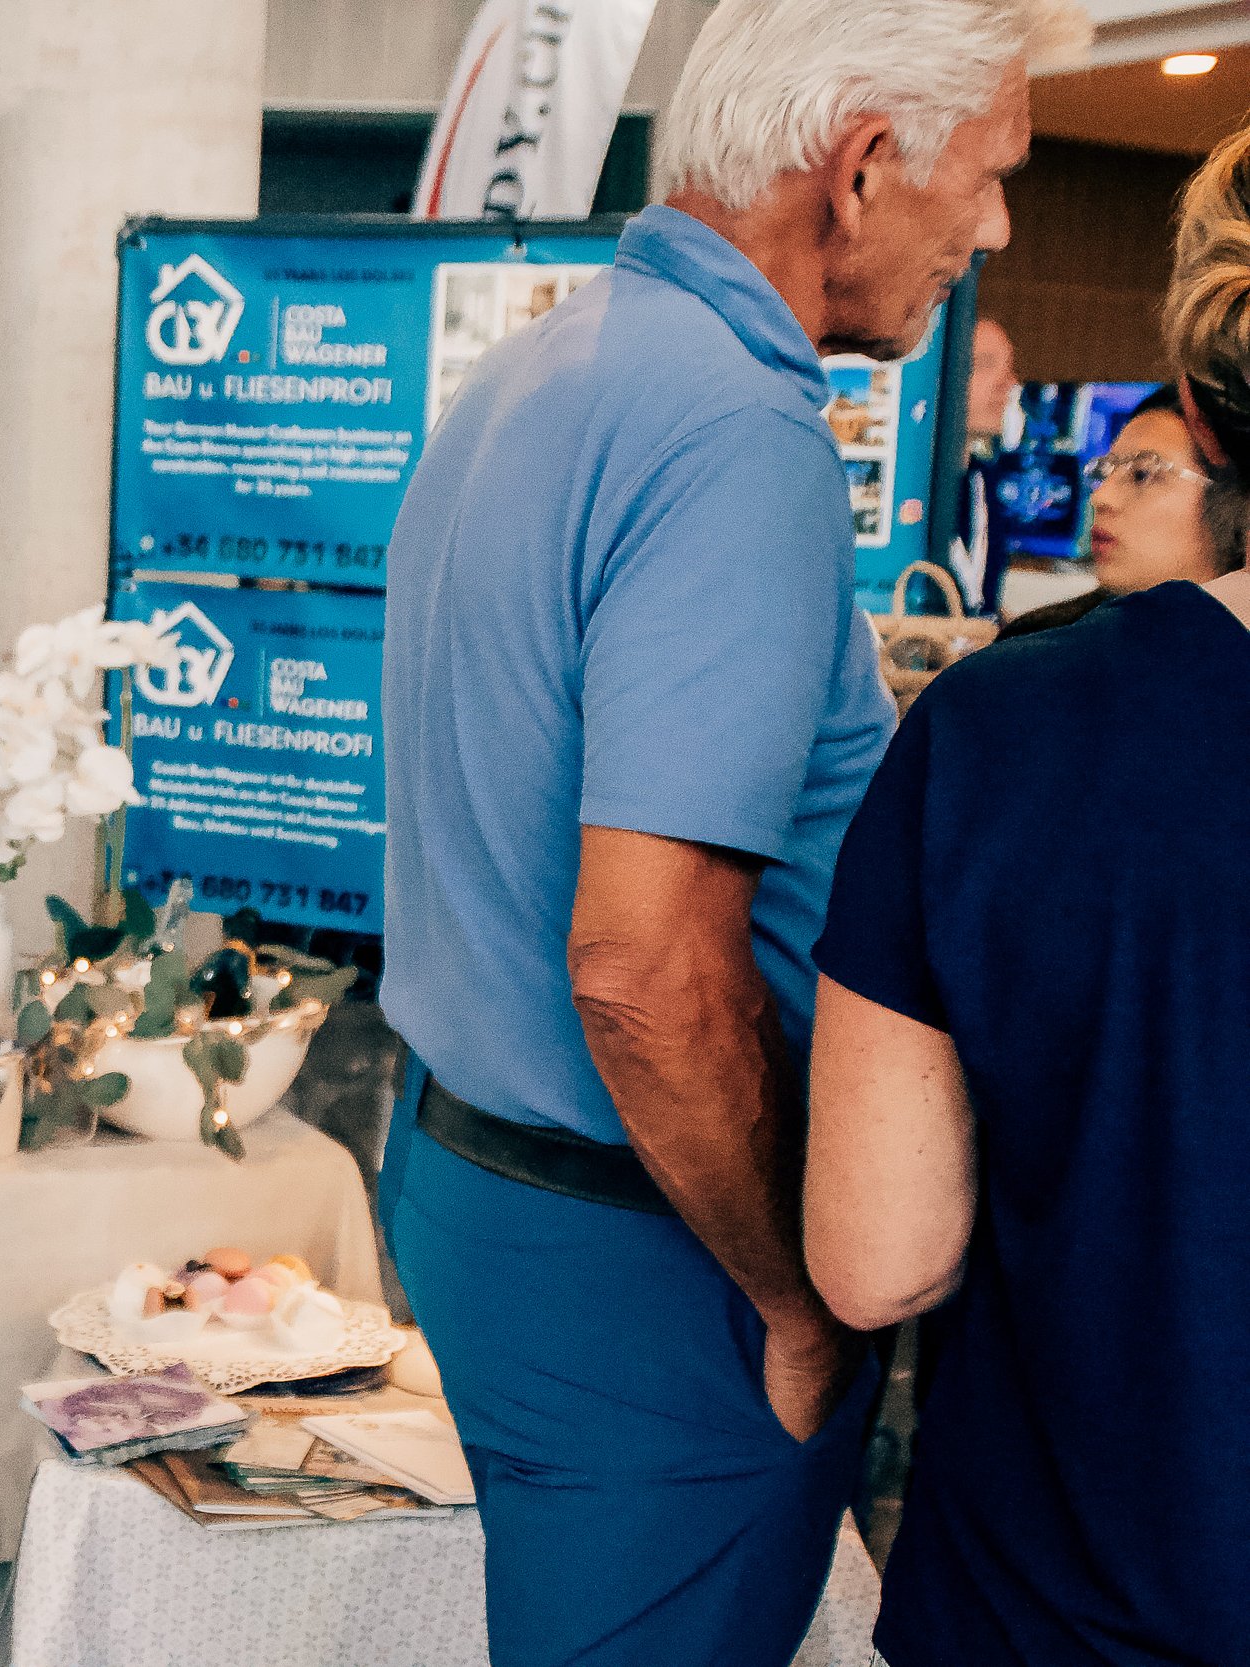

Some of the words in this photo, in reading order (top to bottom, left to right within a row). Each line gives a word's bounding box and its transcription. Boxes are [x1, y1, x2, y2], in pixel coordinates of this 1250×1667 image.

[284, 304, 347, 327] COSTA
[283, 325, 323, 344] BAU
[284, 343, 388, 368] WAGENER
[144, 371, 193, 400] BAU
[224, 373, 394, 405] FLIESENPROFI
[271, 657, 328, 682] COSTA
[270, 696, 369, 721] WAGENER
[133, 713, 181, 740] BAU
[213, 718, 374, 758] FLIESENPROFI
